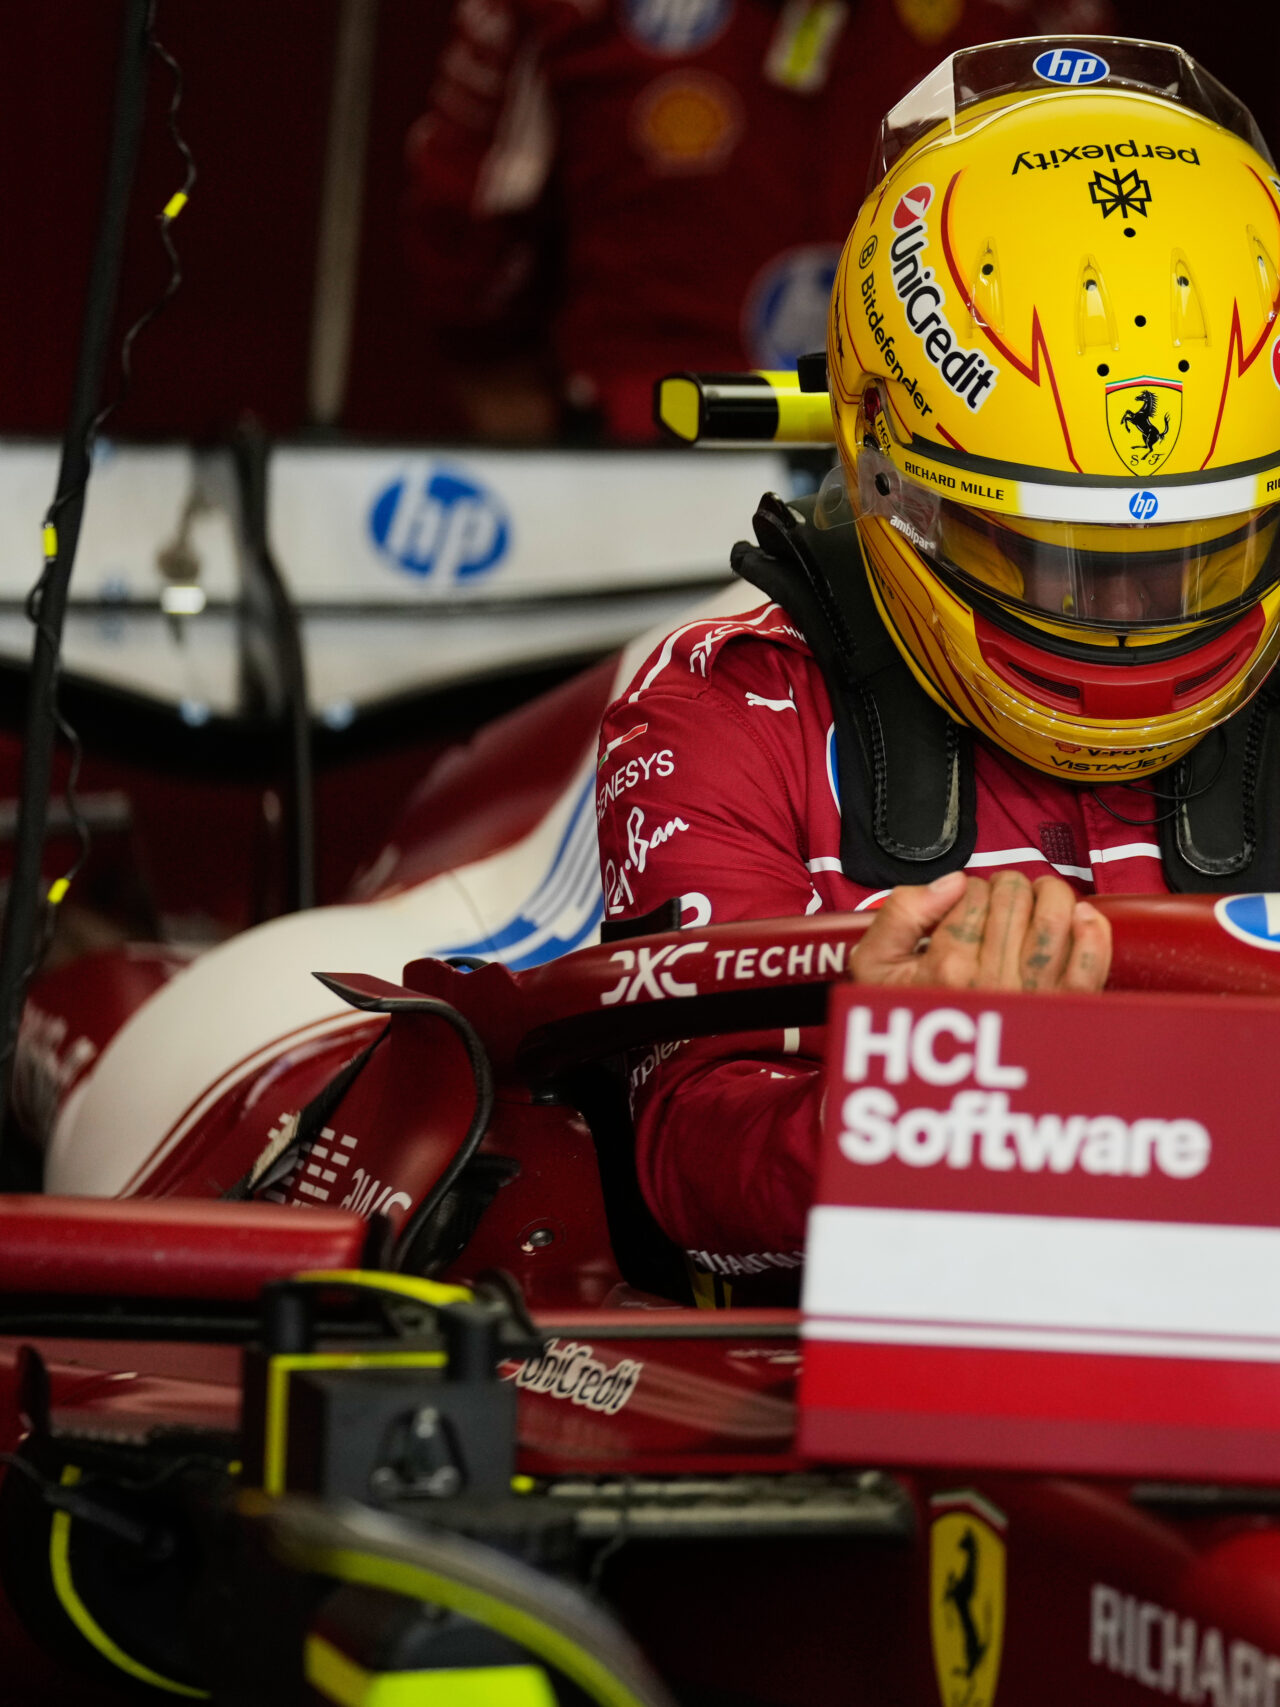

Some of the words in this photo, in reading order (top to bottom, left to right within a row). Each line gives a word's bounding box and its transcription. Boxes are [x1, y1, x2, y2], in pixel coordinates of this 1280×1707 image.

[1045, 49, 1100, 84] hp
[1011, 139, 1201, 176] perplexity
[861, 271, 933, 417] Bitdefender
[890, 223, 995, 410] UniCredit
[904, 460, 956, 490] RICHARD
[960, 480, 1006, 501] MILLE
[1130, 490, 1157, 520] hp
[383, 467, 501, 585] hp
[599, 940, 710, 1006] DXC
[713, 941, 854, 981] TECHN
[842, 1005, 1029, 1090] HCL
[838, 1086, 1212, 1180] Software
